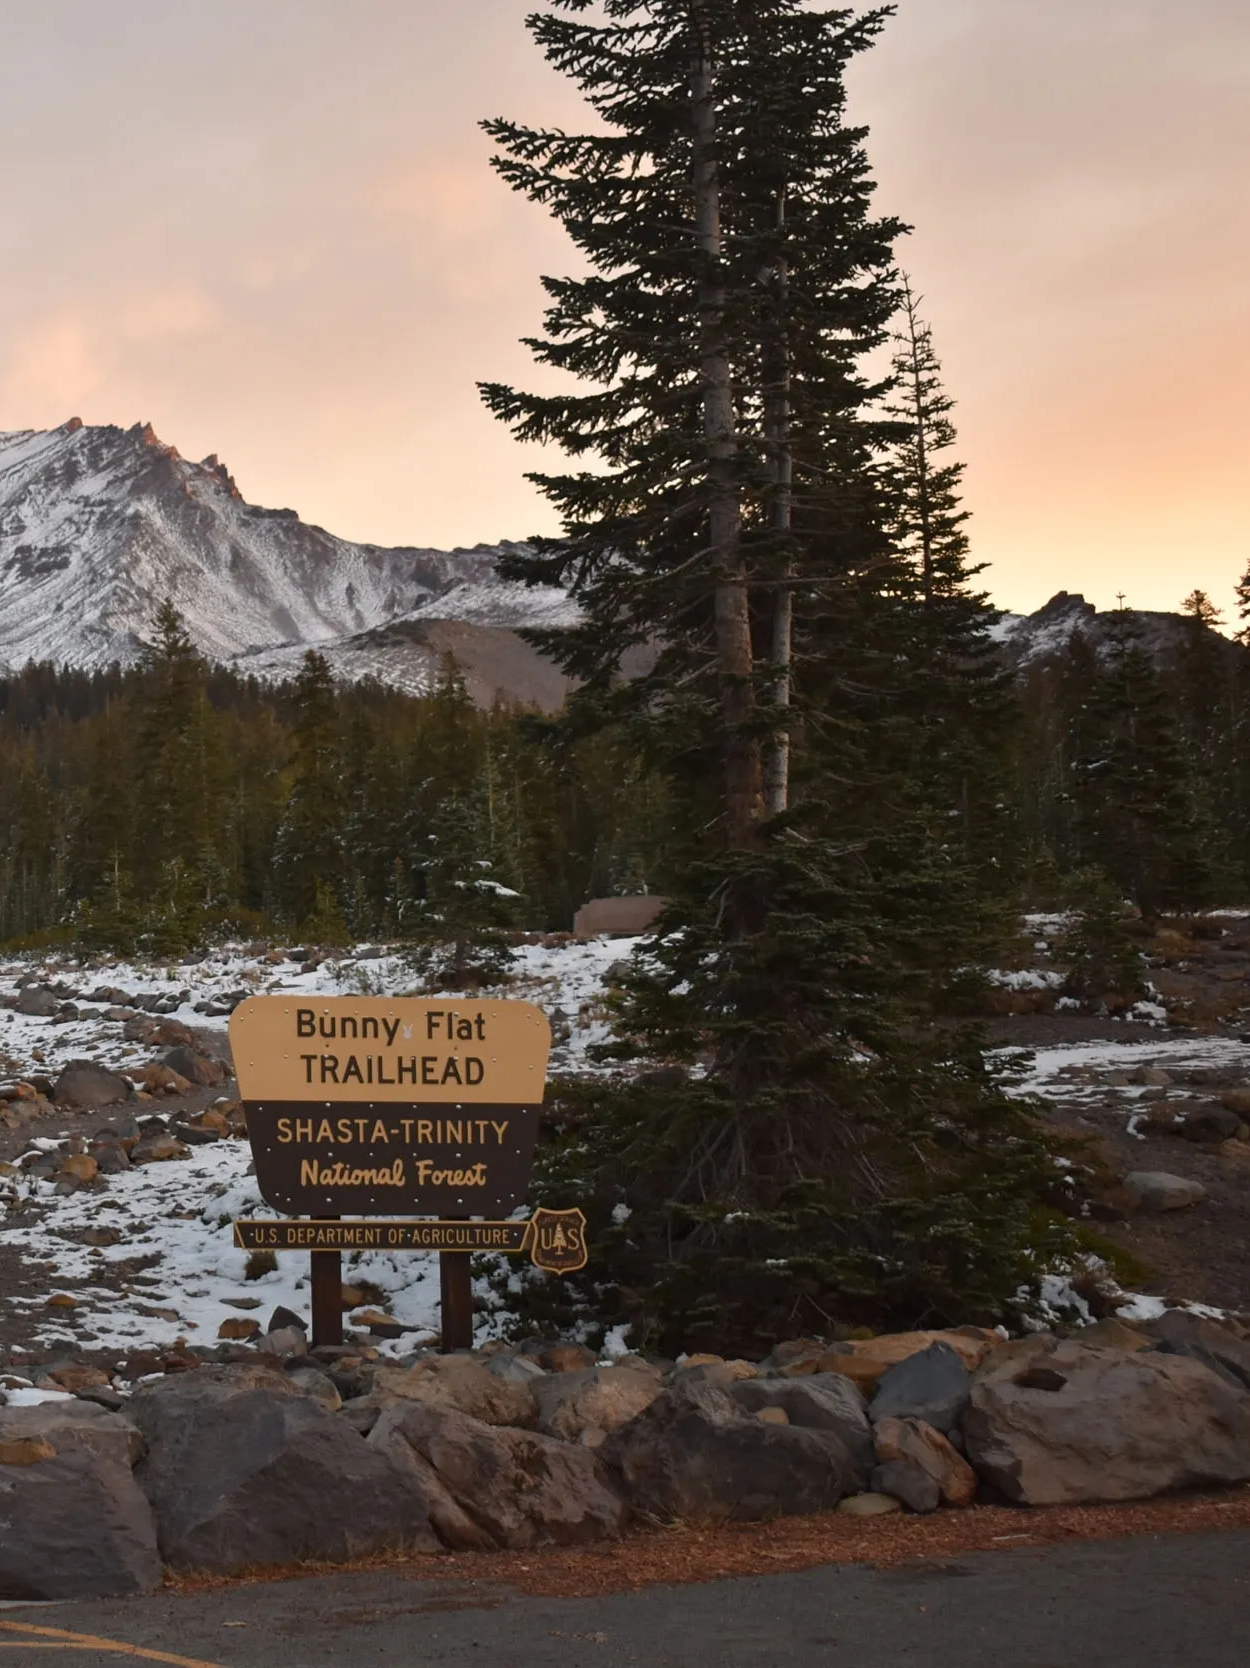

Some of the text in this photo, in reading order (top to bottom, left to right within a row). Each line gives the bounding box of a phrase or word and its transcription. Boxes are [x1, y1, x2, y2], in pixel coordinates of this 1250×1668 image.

[296, 1009, 486, 1047] Bunny Flat
[300, 1054, 485, 1085] TRAILHEAD
[277, 1118, 509, 1144] SHASTA-TRINITY
[300, 1158, 487, 1187] National Forest
[255, 1228, 510, 1244] U.S. DEPARTMENT OF AGRICULTURE
